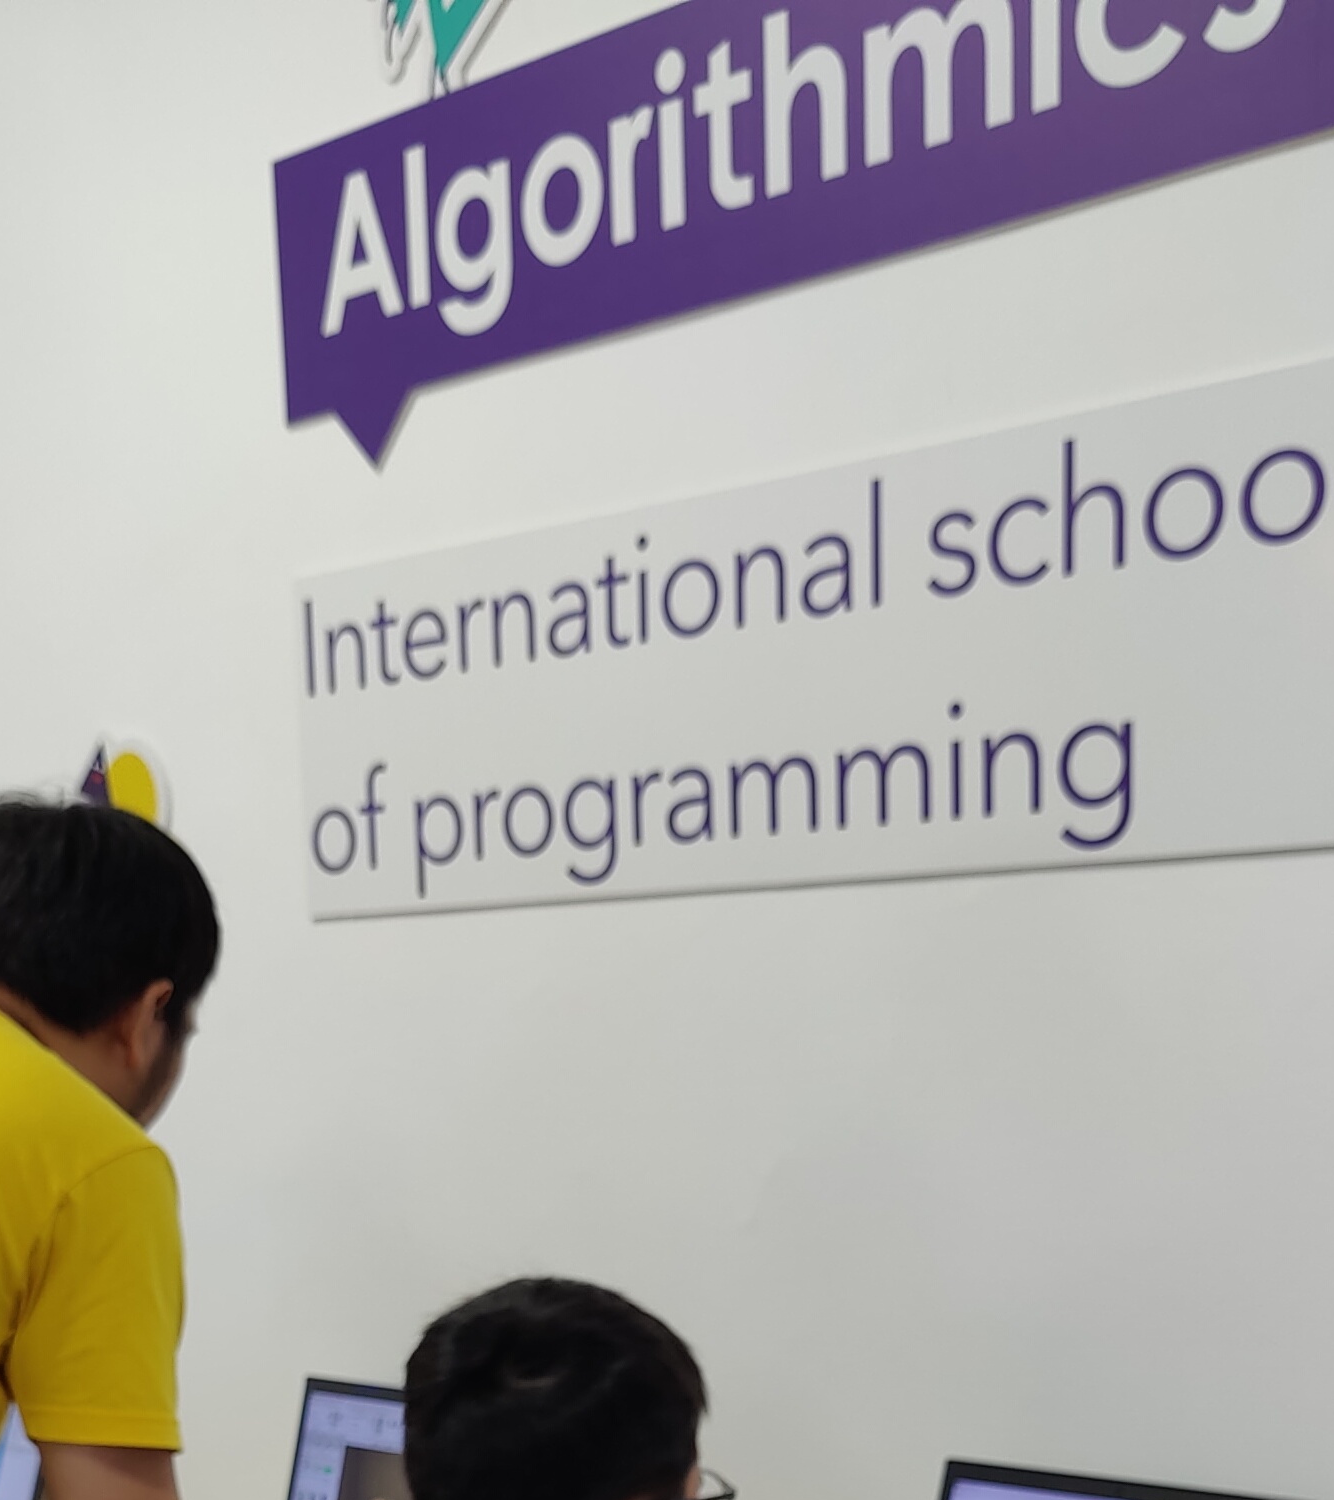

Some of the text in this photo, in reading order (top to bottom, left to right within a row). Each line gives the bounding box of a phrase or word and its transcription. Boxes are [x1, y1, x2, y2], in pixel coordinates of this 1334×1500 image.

[303, 476, 884, 698] International
[310, 701, 1135, 898] of programming
